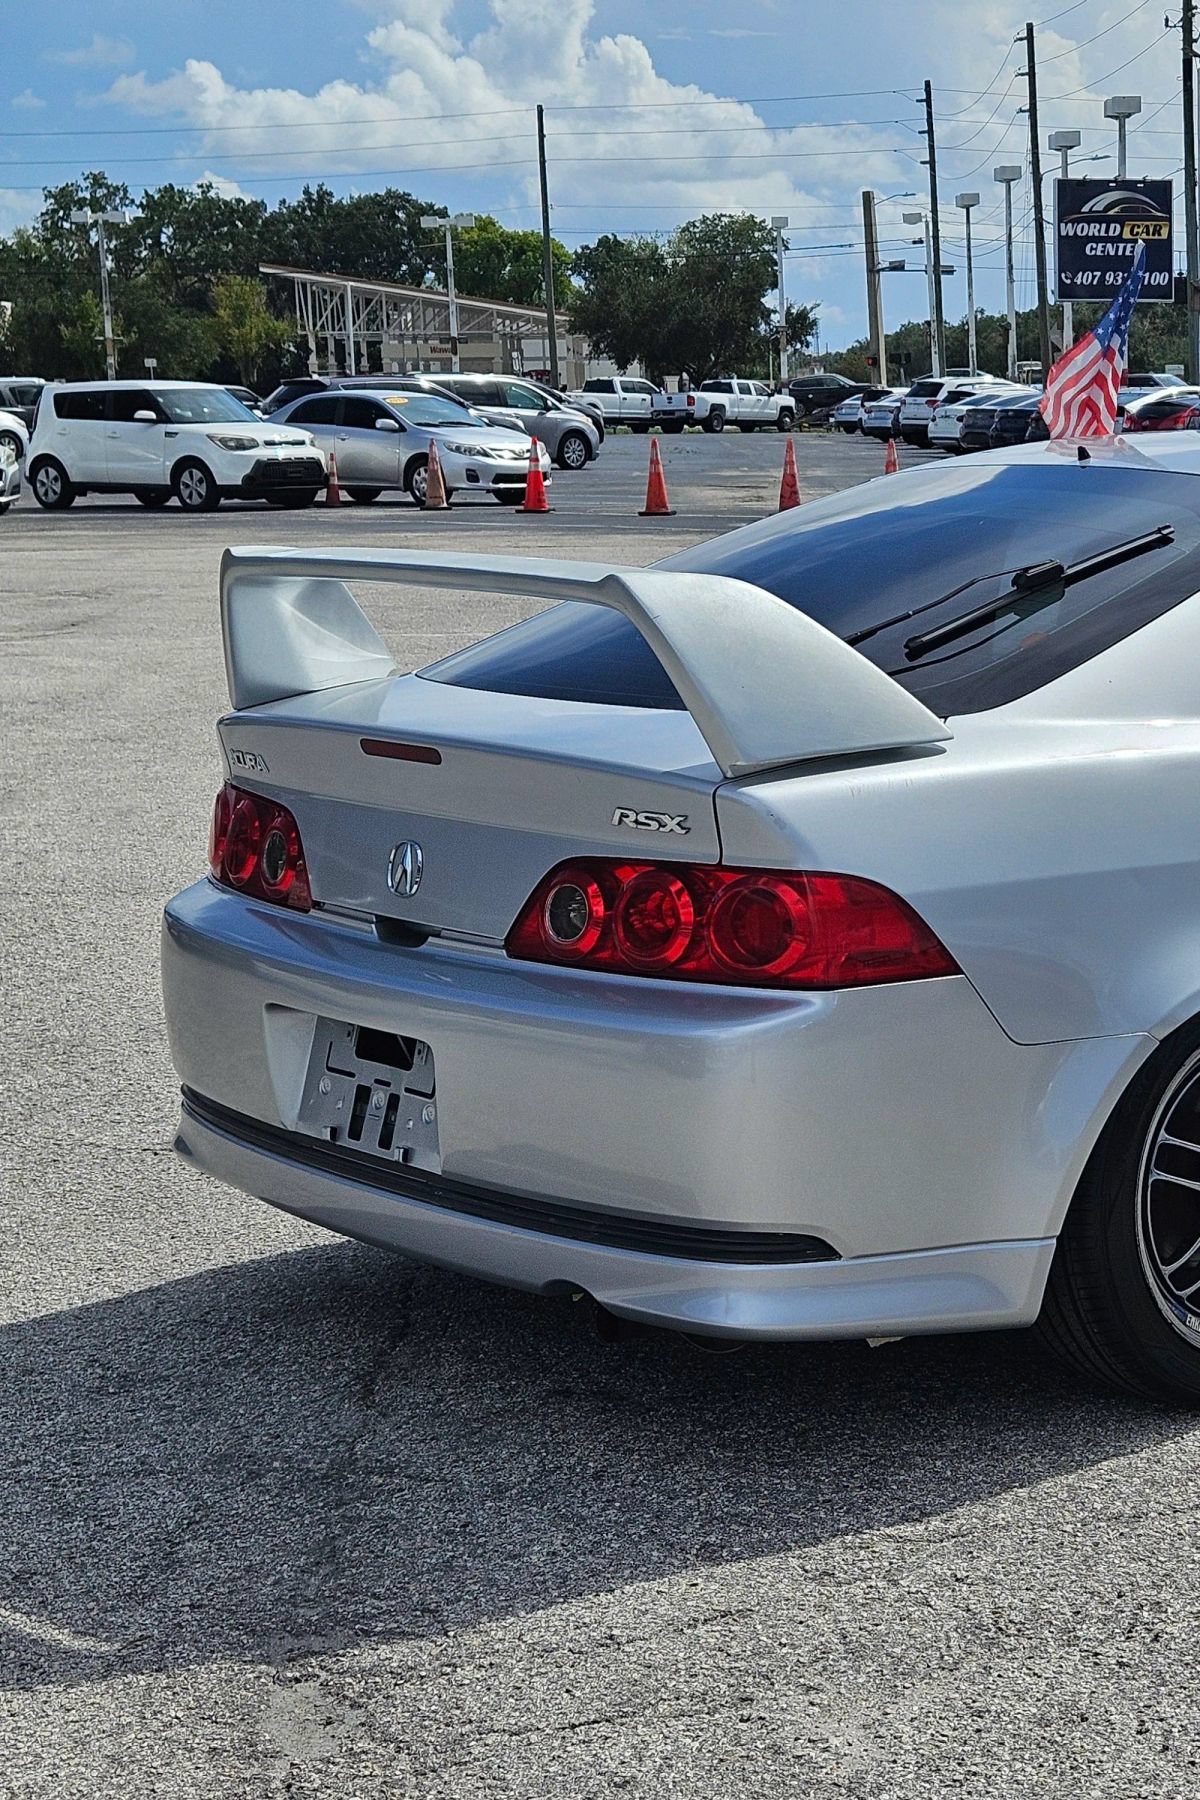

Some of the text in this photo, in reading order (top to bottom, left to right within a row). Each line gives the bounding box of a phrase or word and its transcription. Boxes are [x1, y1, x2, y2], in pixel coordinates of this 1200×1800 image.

[1060, 222, 1163, 237] WORLD CAR
[1085, 243, 1136, 256] CENTE
[1074, 271, 1101, 286] 407
[430, 345, 452, 354] Waw
[611, 806, 692, 835] RSX
